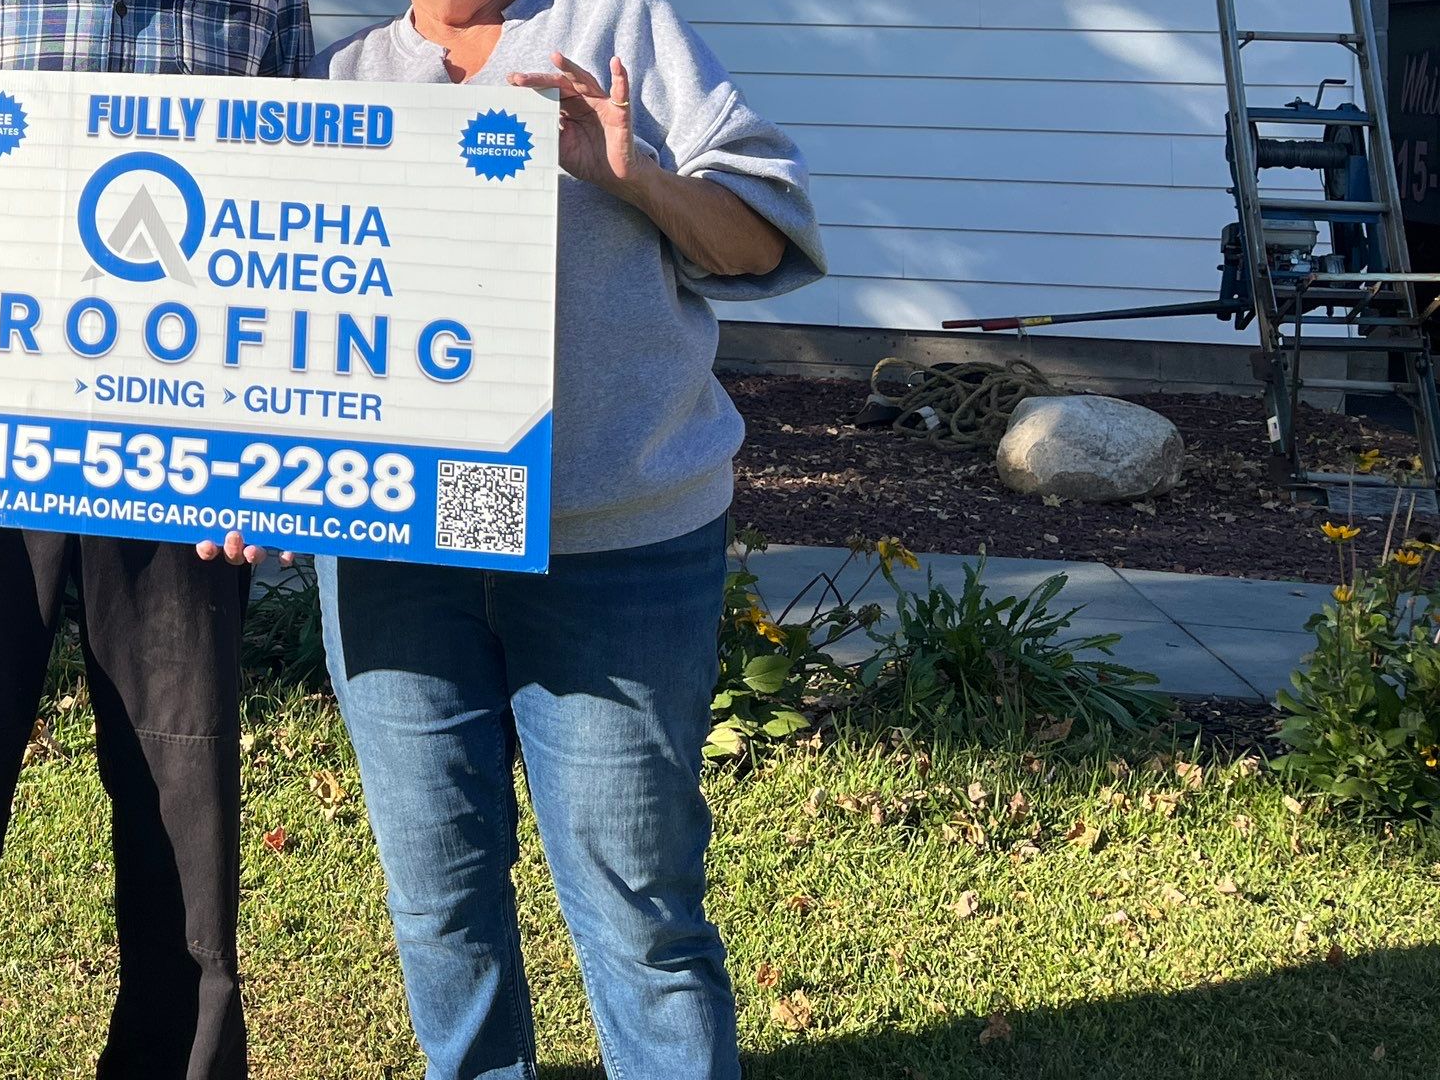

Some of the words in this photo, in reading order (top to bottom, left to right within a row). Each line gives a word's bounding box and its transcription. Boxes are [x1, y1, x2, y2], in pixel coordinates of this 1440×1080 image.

[1401, 51, 1440, 115] Whi
[86, 93, 206, 140] FULLY
[216, 99, 395, 148] INSURED
[477, 131, 516, 147] FREE
[466, 146, 526, 158] INSPECTION
[210, 198, 391, 248] ALPHA
[207, 248, 394, 297] OMEGA
[94, 373, 205, 408] SIDING
[243, 384, 383, 421] GUTTER
